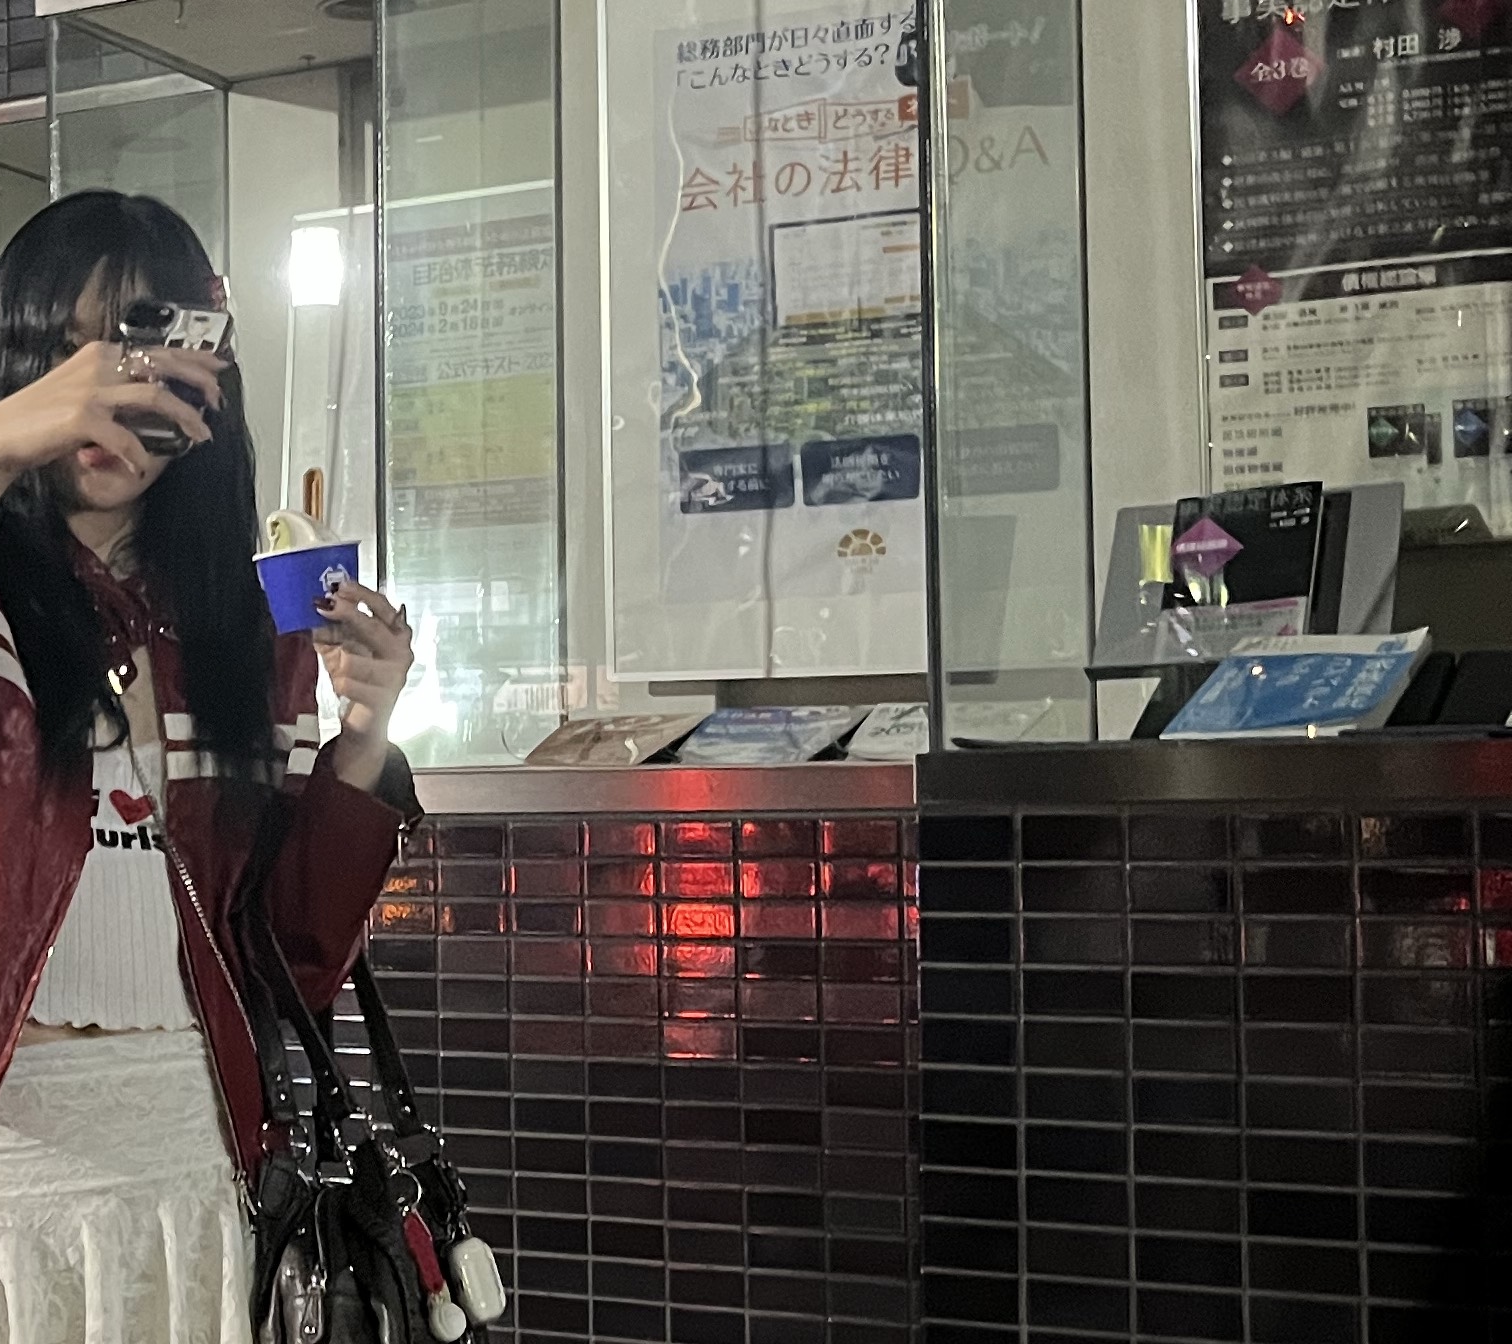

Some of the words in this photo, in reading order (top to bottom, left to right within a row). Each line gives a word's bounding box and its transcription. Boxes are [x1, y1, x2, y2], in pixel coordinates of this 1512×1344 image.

[681, 145, 915, 213] 会社の法律
